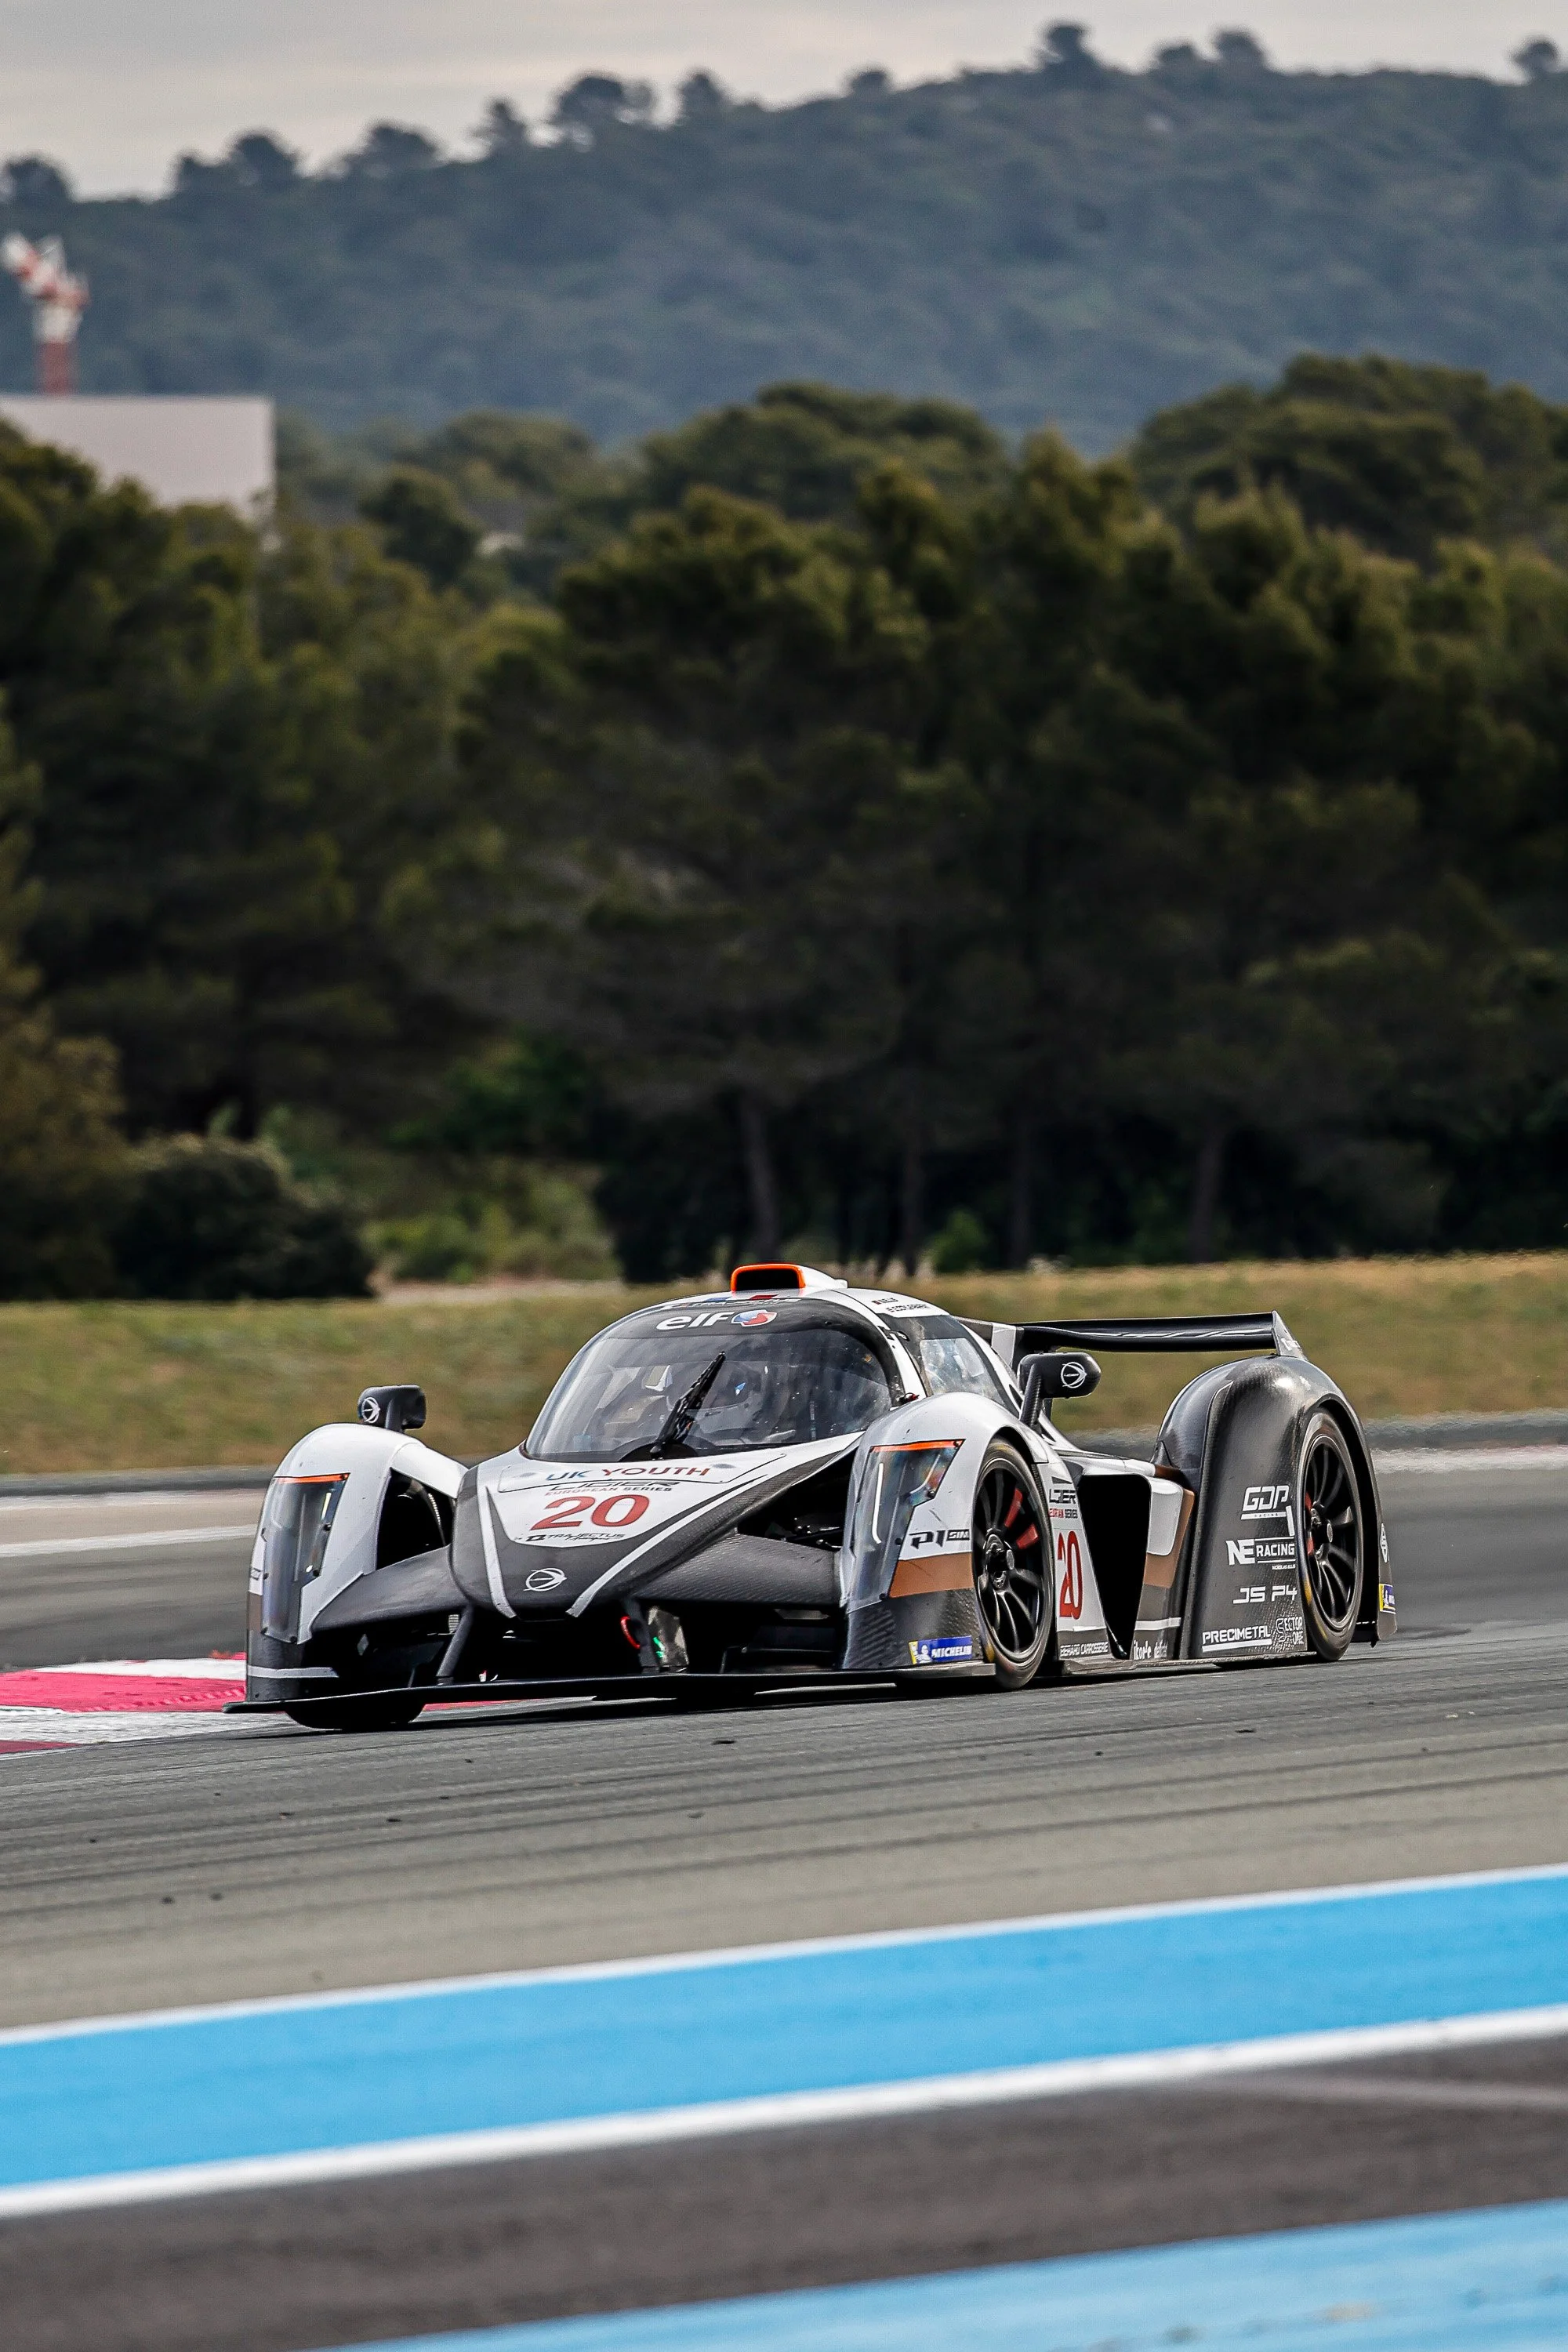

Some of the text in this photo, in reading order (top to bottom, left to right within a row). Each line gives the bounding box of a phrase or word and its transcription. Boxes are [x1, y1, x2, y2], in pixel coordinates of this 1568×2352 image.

[656, 1312, 735, 1330] elf
[546, 1467, 710, 1481] UK YOUTH
[1242, 1485, 1290, 1512] GDP
[530, 1494, 650, 1531] 20
[1225, 1538, 1295, 1566] NE RACING
[1058, 1530, 1083, 1620] 20
[1271, 1584, 1298, 1602] P4
[1202, 1624, 1272, 1645] PRECIMETAL
[931, 1645, 973, 1658] MICHELIN
